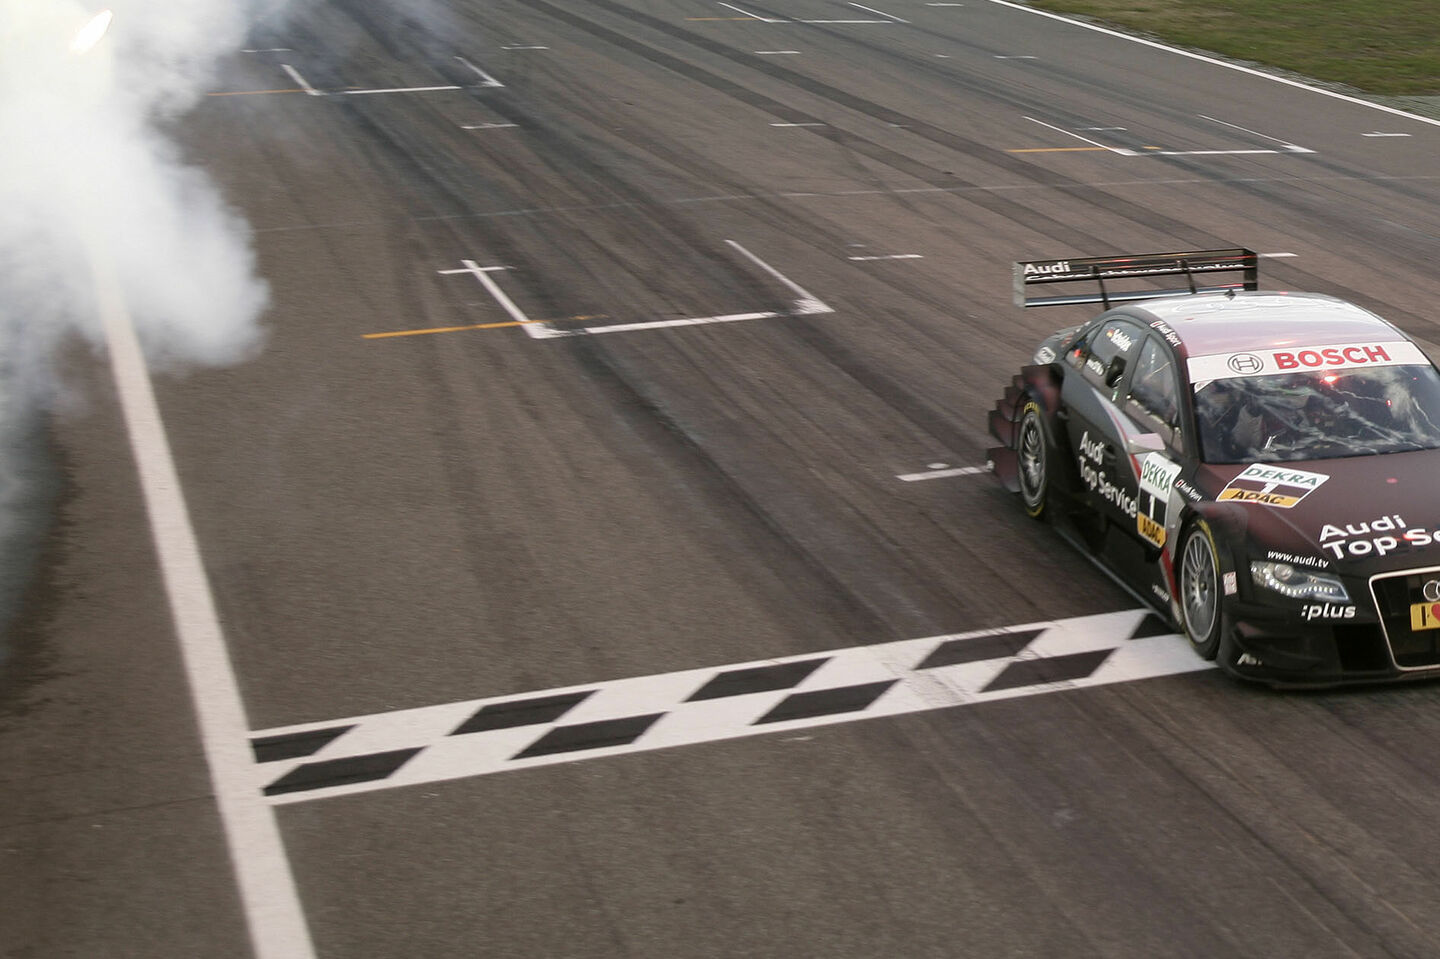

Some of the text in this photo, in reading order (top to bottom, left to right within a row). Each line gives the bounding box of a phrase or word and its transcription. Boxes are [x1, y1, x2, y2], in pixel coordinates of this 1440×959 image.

[1024, 261, 1071, 275] Audi
[1273, 345, 1392, 370] BOSCH
[1080, 431, 1104, 465] Audi
[1079, 455, 1138, 519] Top Service
[1142, 460, 1173, 494] DEKRA
[1243, 468, 1318, 486] DEKRA
[1260, 480, 1280, 494] 1
[1148, 493, 1156, 520] 1
[1230, 490, 1285, 505] ADAC
[1319, 514, 1407, 542] Audi
[1267, 550, 1329, 568] www.audi.tv
[1322, 535, 1398, 560] Top
